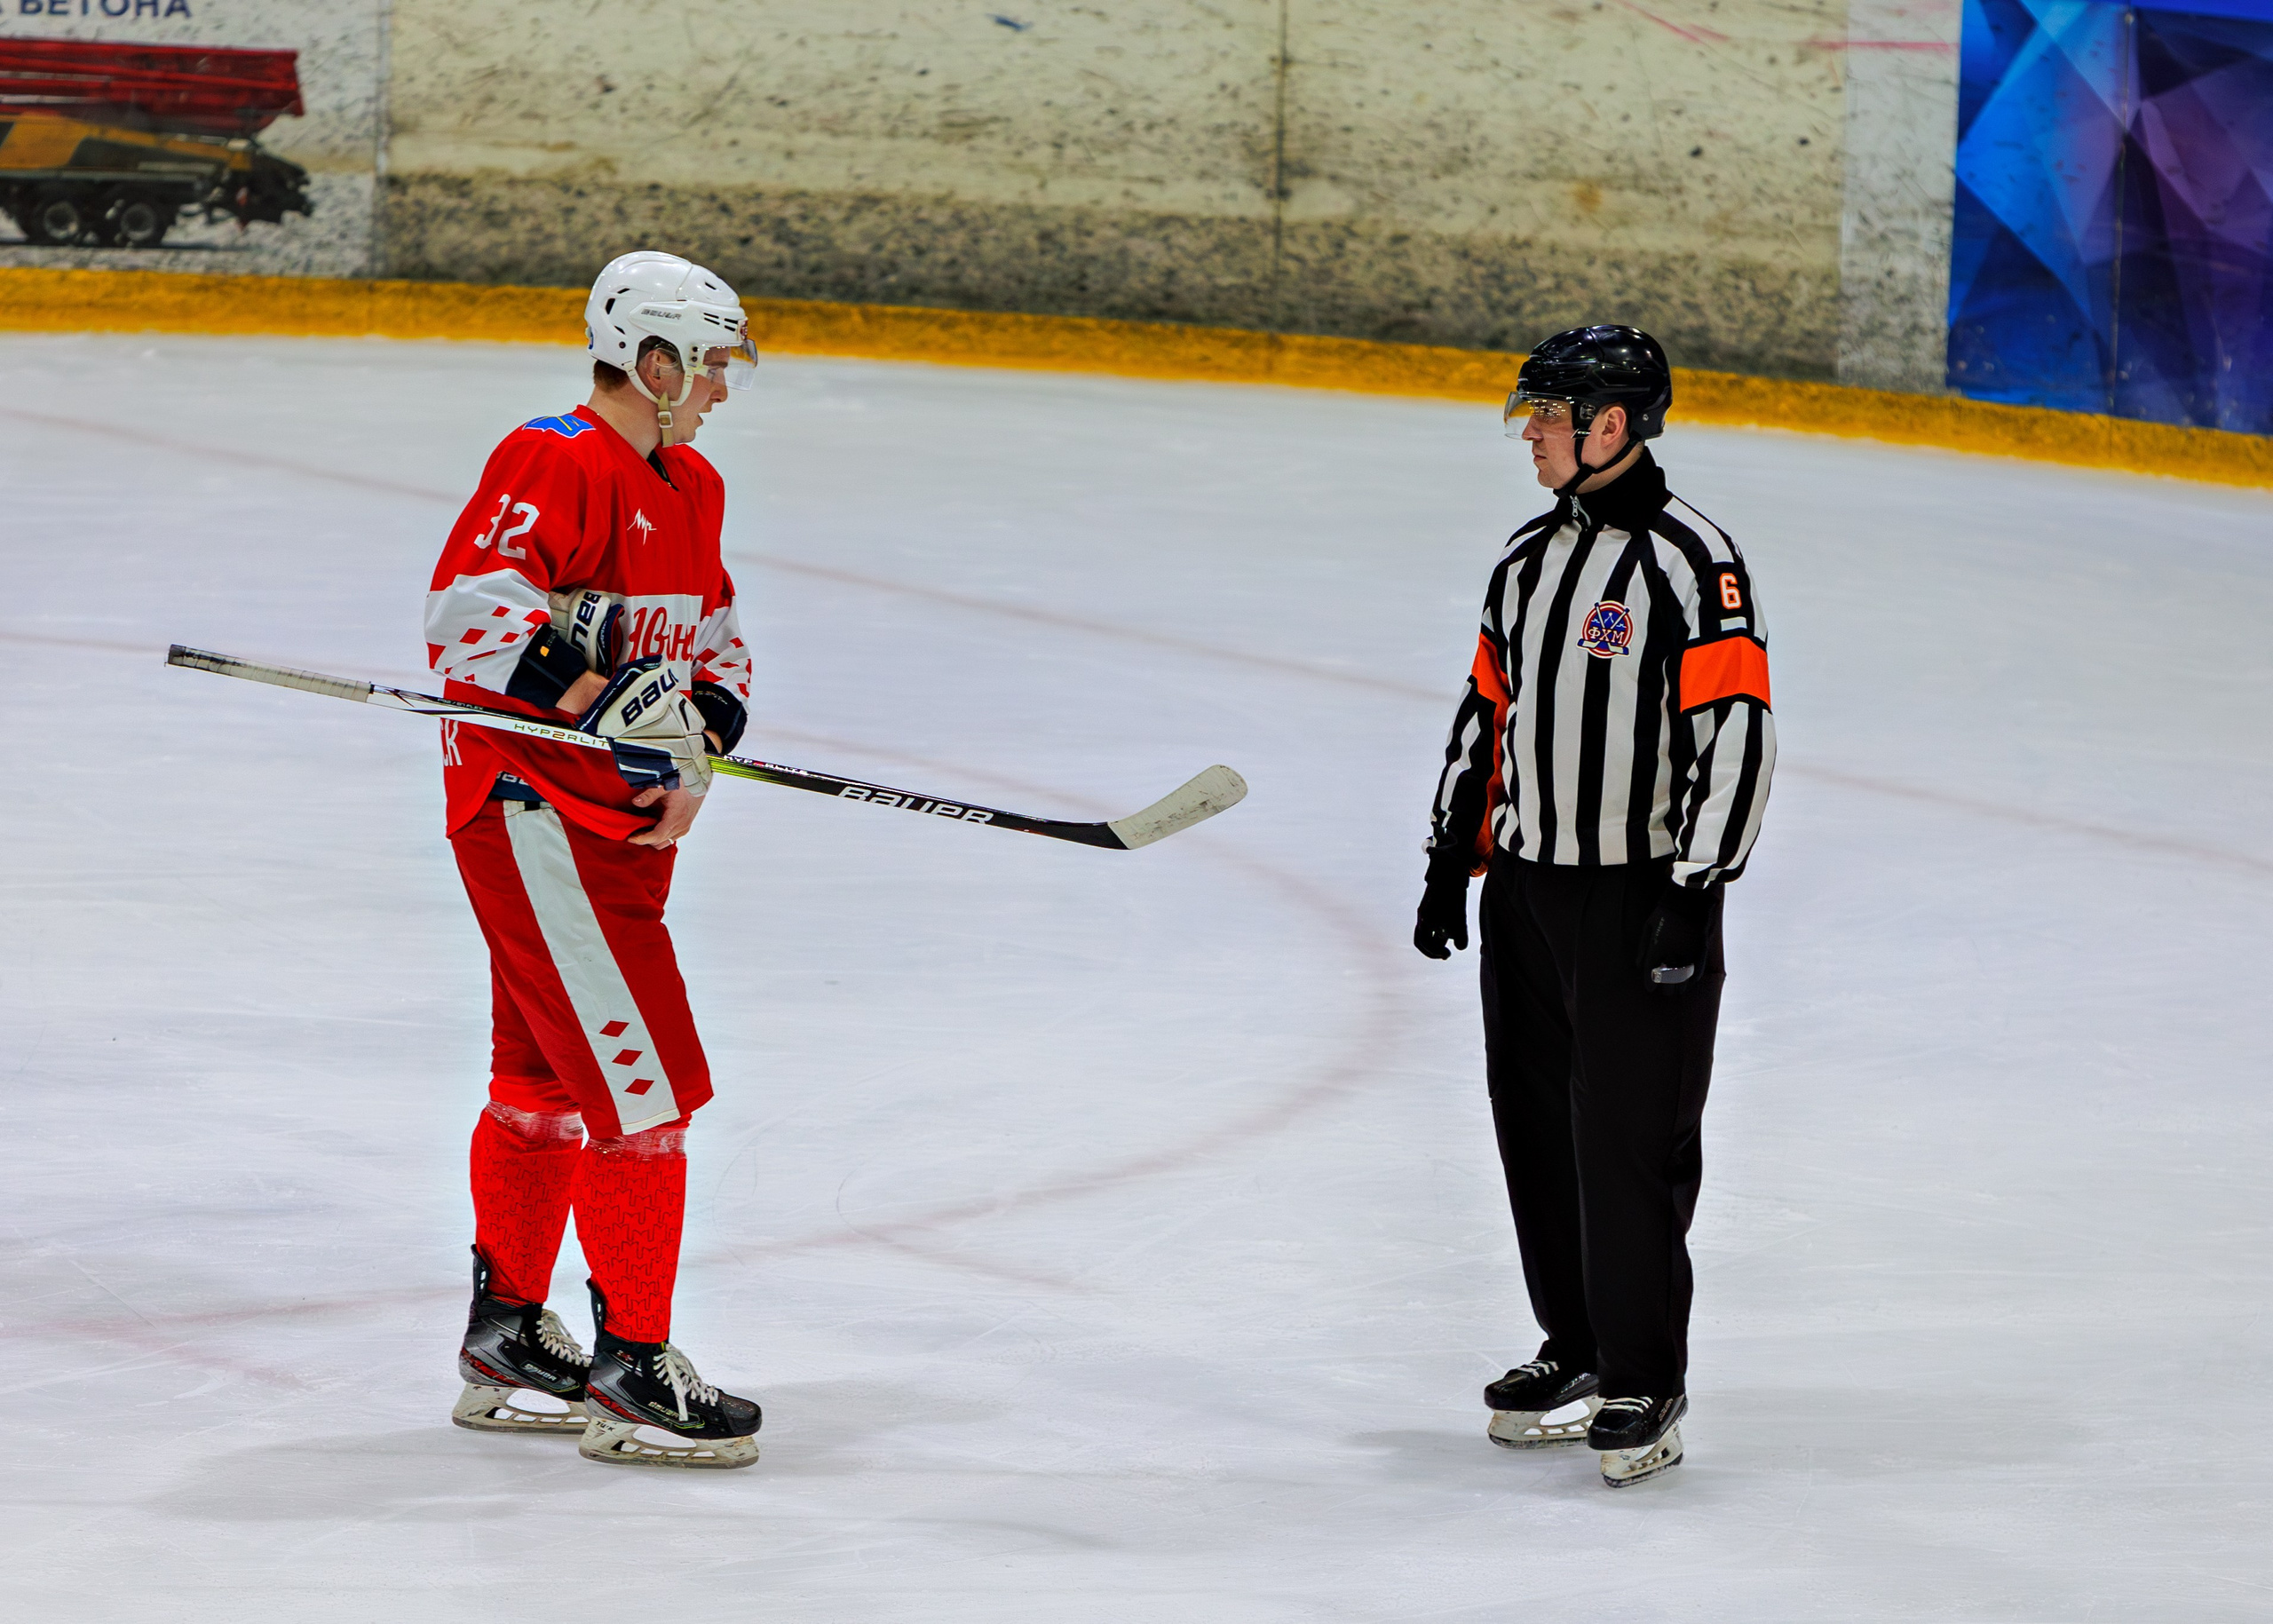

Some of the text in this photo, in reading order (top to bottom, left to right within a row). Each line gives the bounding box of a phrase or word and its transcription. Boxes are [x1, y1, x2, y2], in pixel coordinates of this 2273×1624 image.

[20, 0, 192, 17] БЕТОНА
[473, 494, 540, 561] 32
[1719, 572, 1743, 610] 6
[570, 590, 602, 655] BAU
[1588, 625, 1626, 646] ФХМ
[620, 668, 680, 728] BAU
[513, 723, 609, 748] HYP2RLIT
[597, 1420, 616, 1433] TUK
